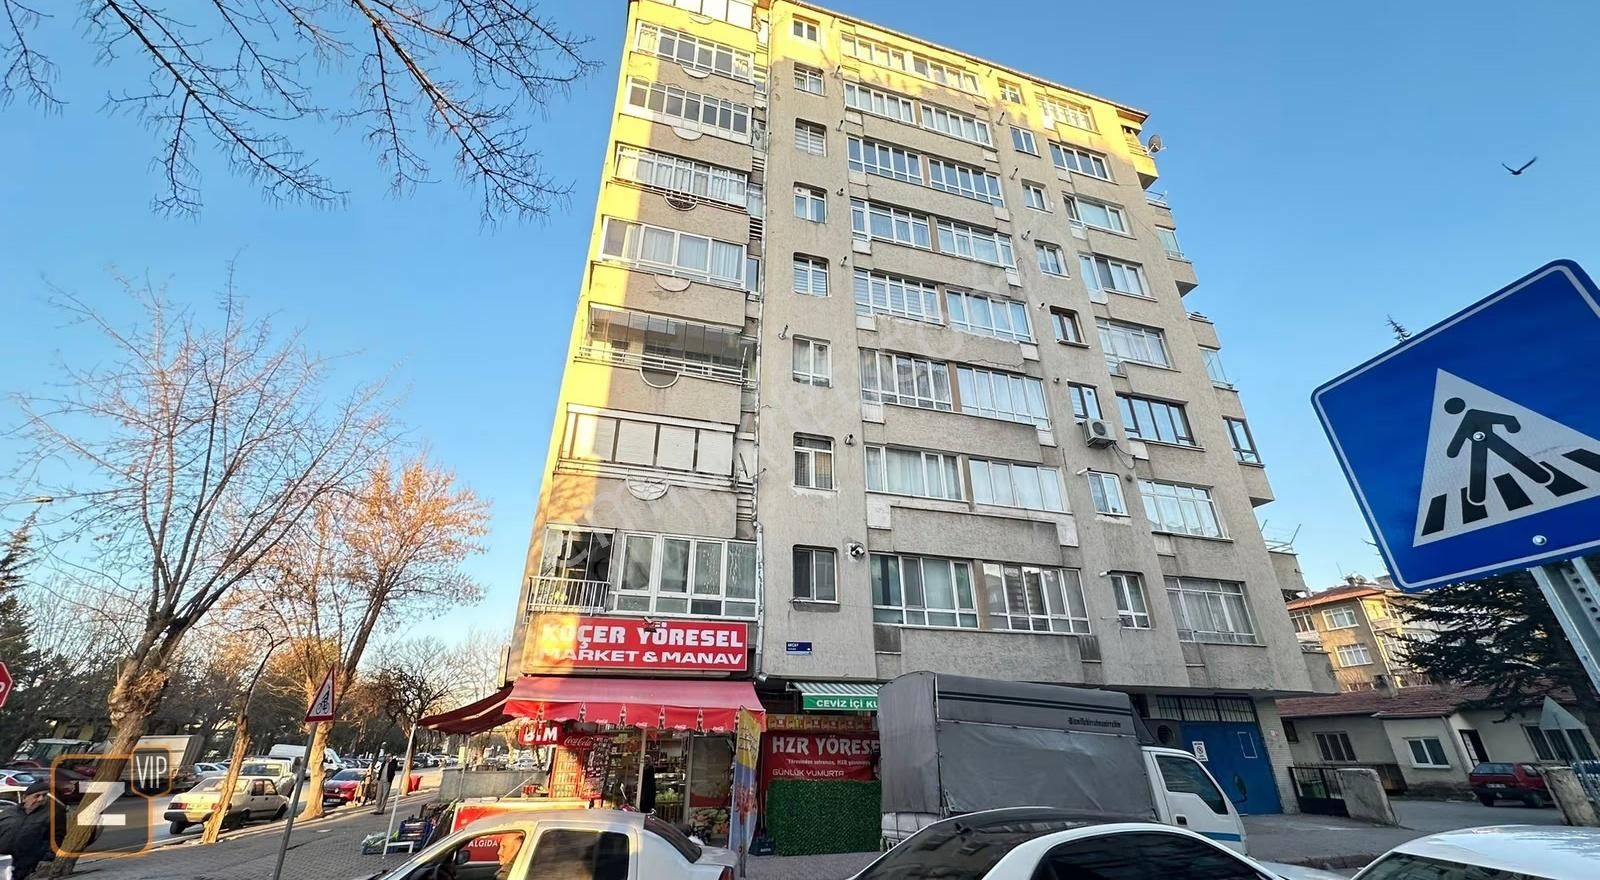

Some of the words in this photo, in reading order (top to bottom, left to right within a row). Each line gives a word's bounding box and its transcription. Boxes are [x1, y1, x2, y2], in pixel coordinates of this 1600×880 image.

[637, 621, 743, 648] YÖRESEL
[542, 648, 639, 662] MARKET
[642, 650, 658, 663] &
[662, 651, 743, 665] MANAV
[816, 698, 847, 708] CEVİZ
[850, 699, 863, 709] İÇİ
[772, 736, 809, 756] HZR
[772, 768, 804, 777] GÜNLÜK
[805, 769, 845, 777] YUMURTA
